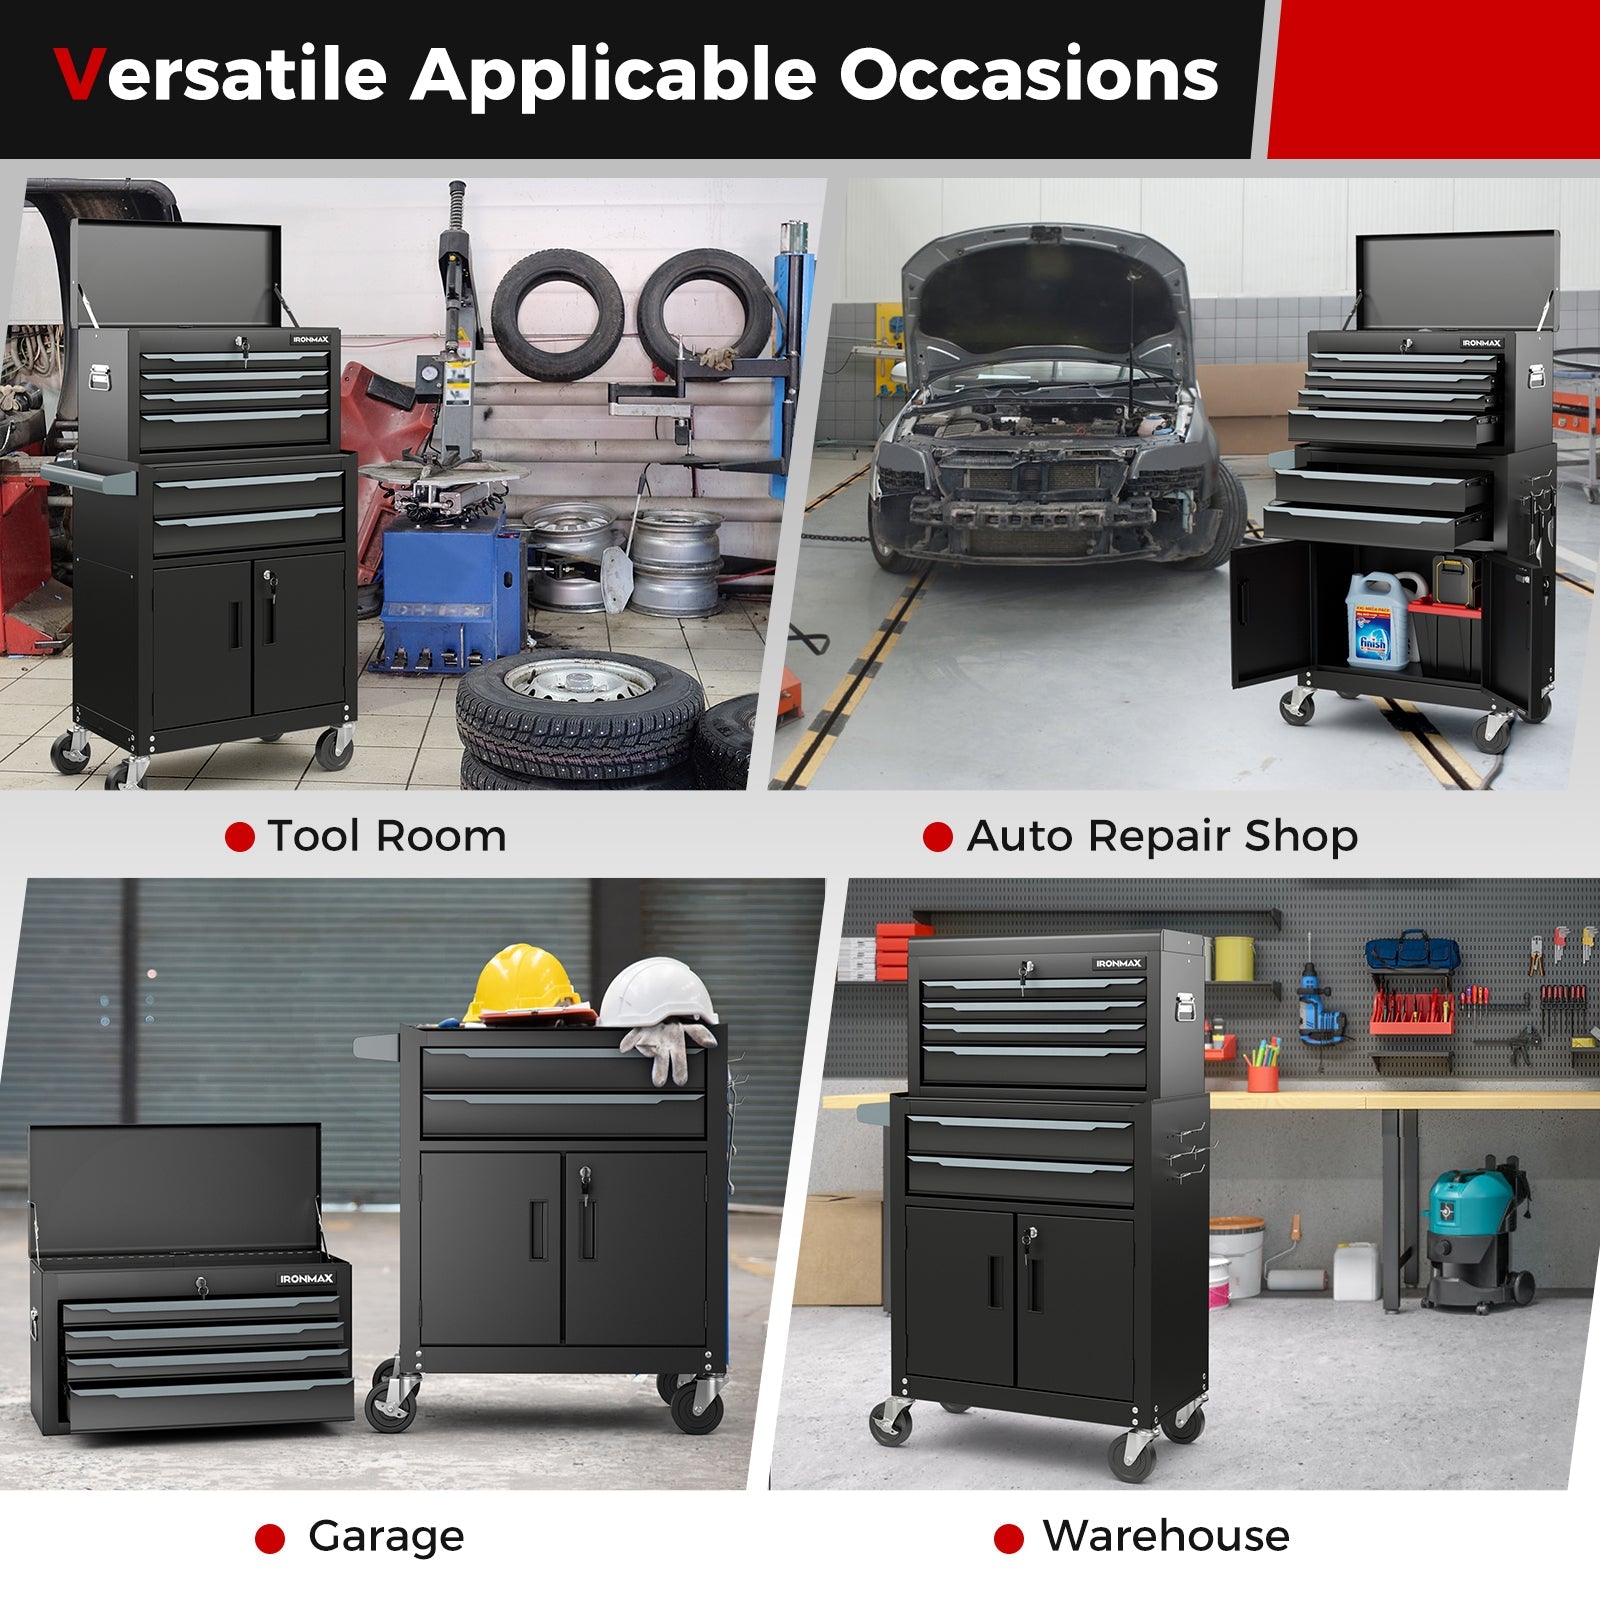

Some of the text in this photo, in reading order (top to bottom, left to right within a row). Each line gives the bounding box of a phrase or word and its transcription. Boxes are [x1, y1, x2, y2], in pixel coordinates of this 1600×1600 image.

[293, 335, 329, 344] IRONMAX
[1462, 339, 1502, 347] IRONMAX
[1360, 637, 1386, 649] finish
[1096, 959, 1142, 968] IRONMAX
[280, 1273, 334, 1284] IRONMAX
